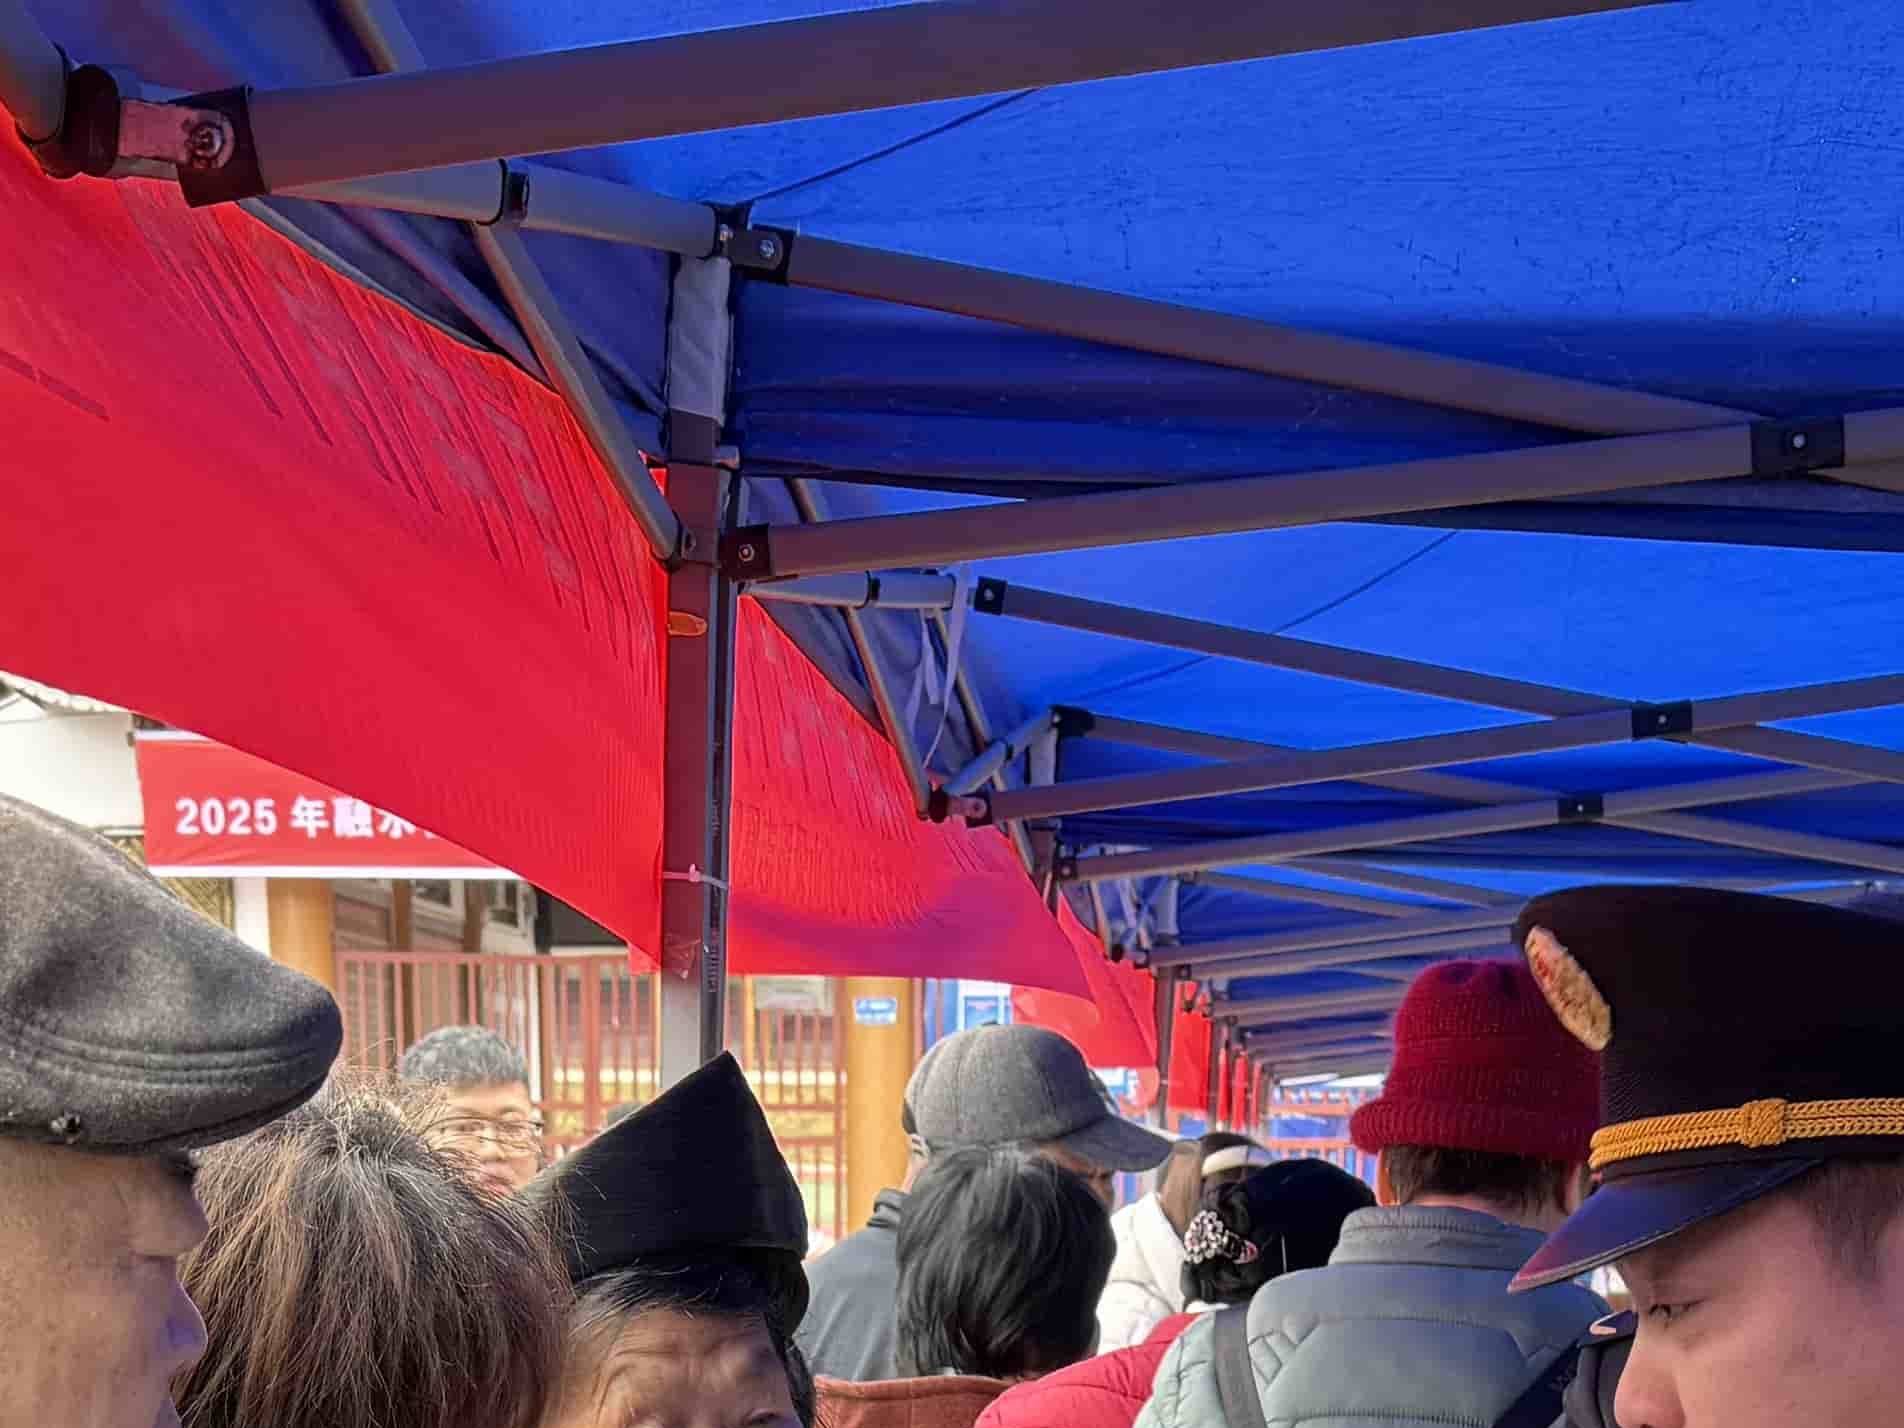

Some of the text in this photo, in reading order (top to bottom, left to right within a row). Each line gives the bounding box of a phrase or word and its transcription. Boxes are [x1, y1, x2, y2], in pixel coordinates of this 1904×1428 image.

[175, 795, 443, 838] 2025 年融水
